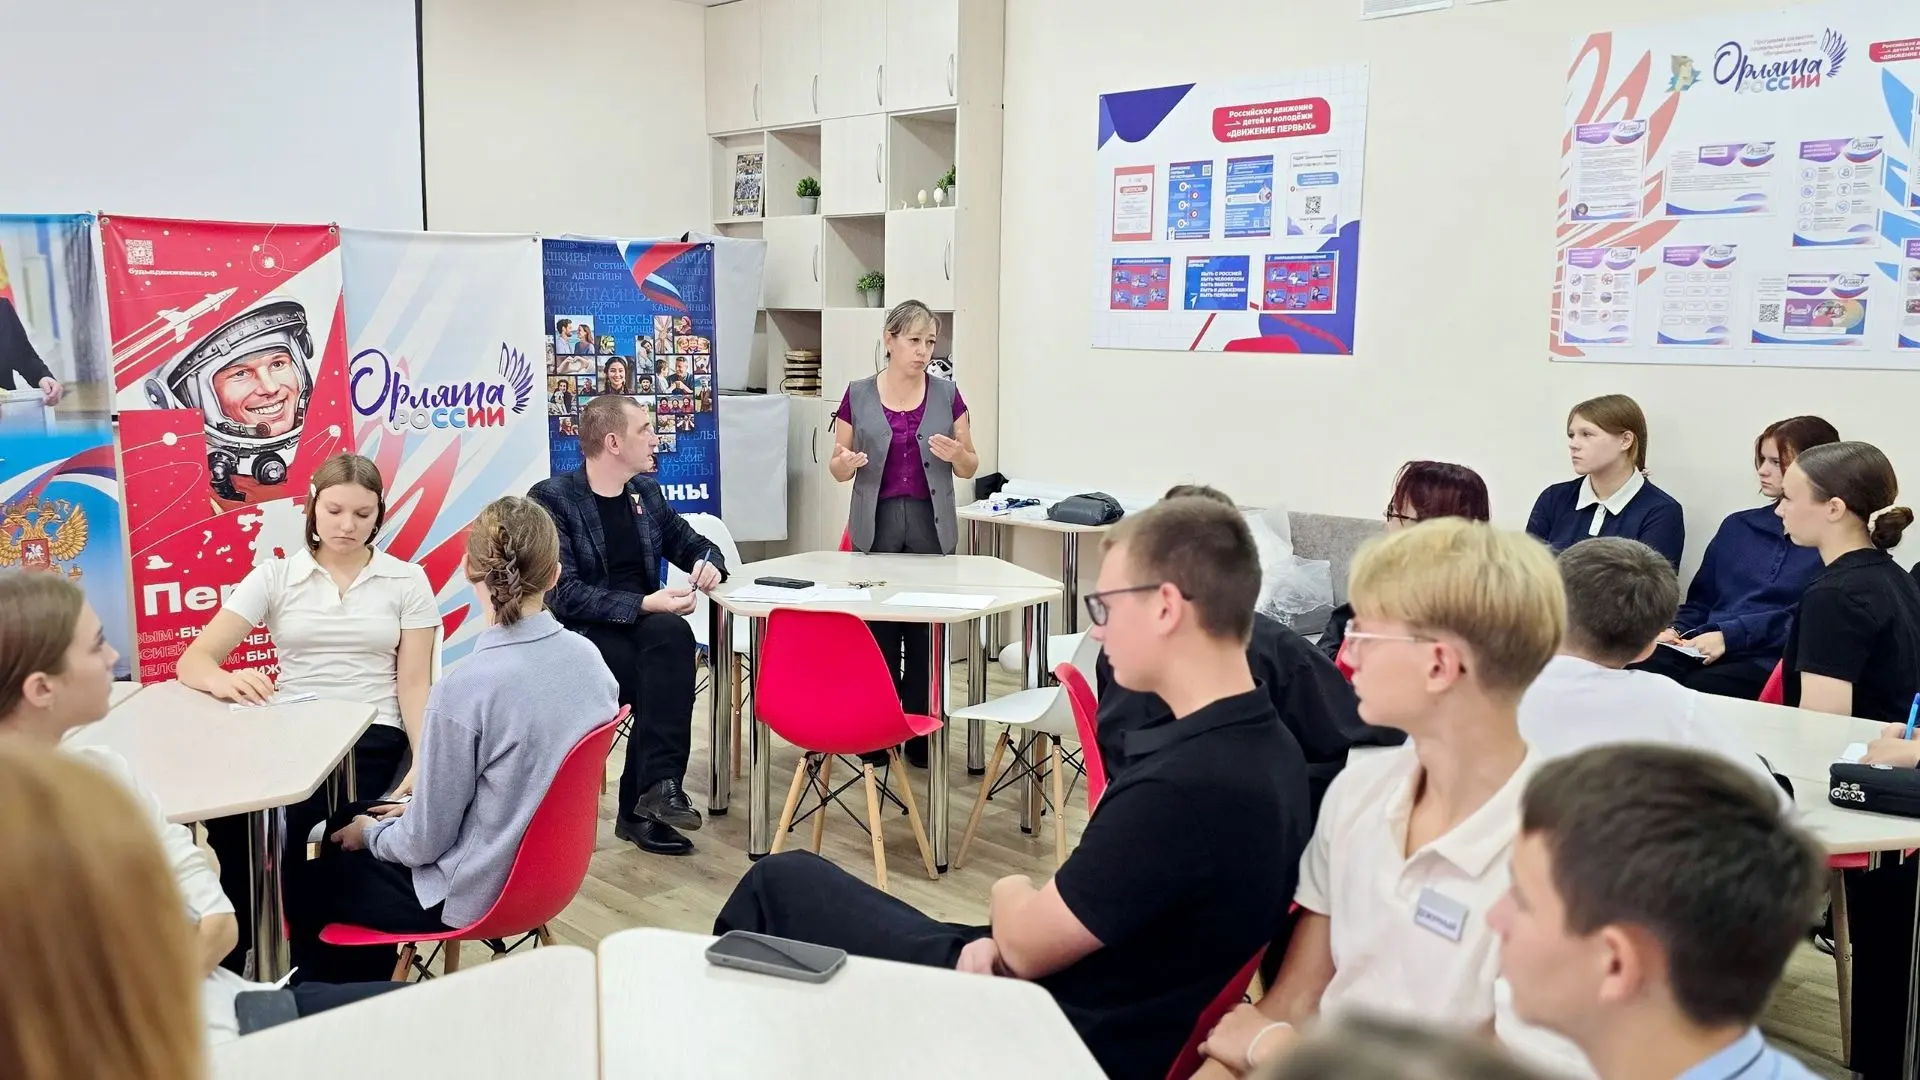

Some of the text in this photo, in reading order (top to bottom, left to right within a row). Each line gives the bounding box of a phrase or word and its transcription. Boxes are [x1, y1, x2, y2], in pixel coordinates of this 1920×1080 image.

[1713, 41, 1823, 92] Орлята
[1739, 73, 1821, 94] РОССИИ
[1228, 103, 1314, 119] Российское движение
[1242, 116, 1265, 127] детей
[1272, 111, 1313, 123] молодёжи
[1226, 122, 1317, 138] «ДВИЖЕНИЕ ПЕРВЫХ»
[544, 252, 590, 263] ШКИРЫ
[571, 271, 622, 281] АДЫГЕЙЦЫ
[598, 314, 654, 325] ЧЕРКЕСЫ
[348, 348, 506, 423] Орлята
[393, 406, 506, 431] РОССИИ
